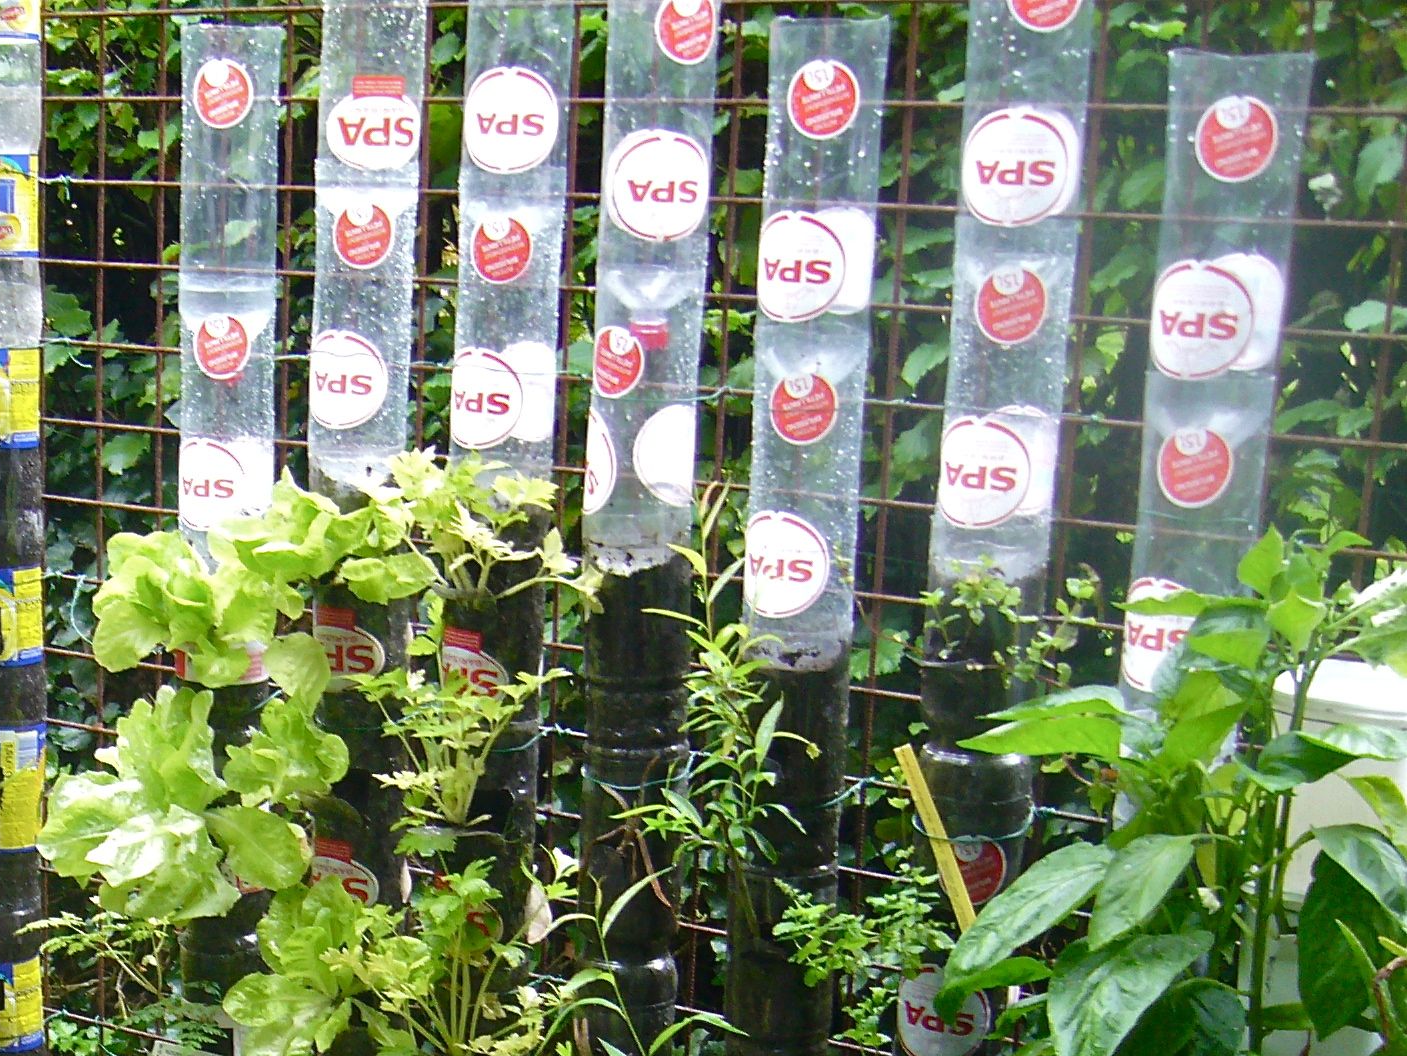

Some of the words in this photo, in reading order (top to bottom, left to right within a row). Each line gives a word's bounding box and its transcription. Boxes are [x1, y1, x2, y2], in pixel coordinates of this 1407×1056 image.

[337, 117, 414, 147] SPA
[476, 113, 544, 137] SPA
[976, 160, 1055, 187] SPA
[627, 180, 698, 203] SPA
[763, 258, 832, 285] SPA
[1159, 310, 1238, 341] SPA
[315, 371, 372, 396] SPA
[454, 390, 510, 416] SPA
[182, 477, 234, 499] SPA
[945, 461, 1017, 492] SPA
[749, 553, 813, 583] SPA
[904, 1000, 975, 1038] SPA
